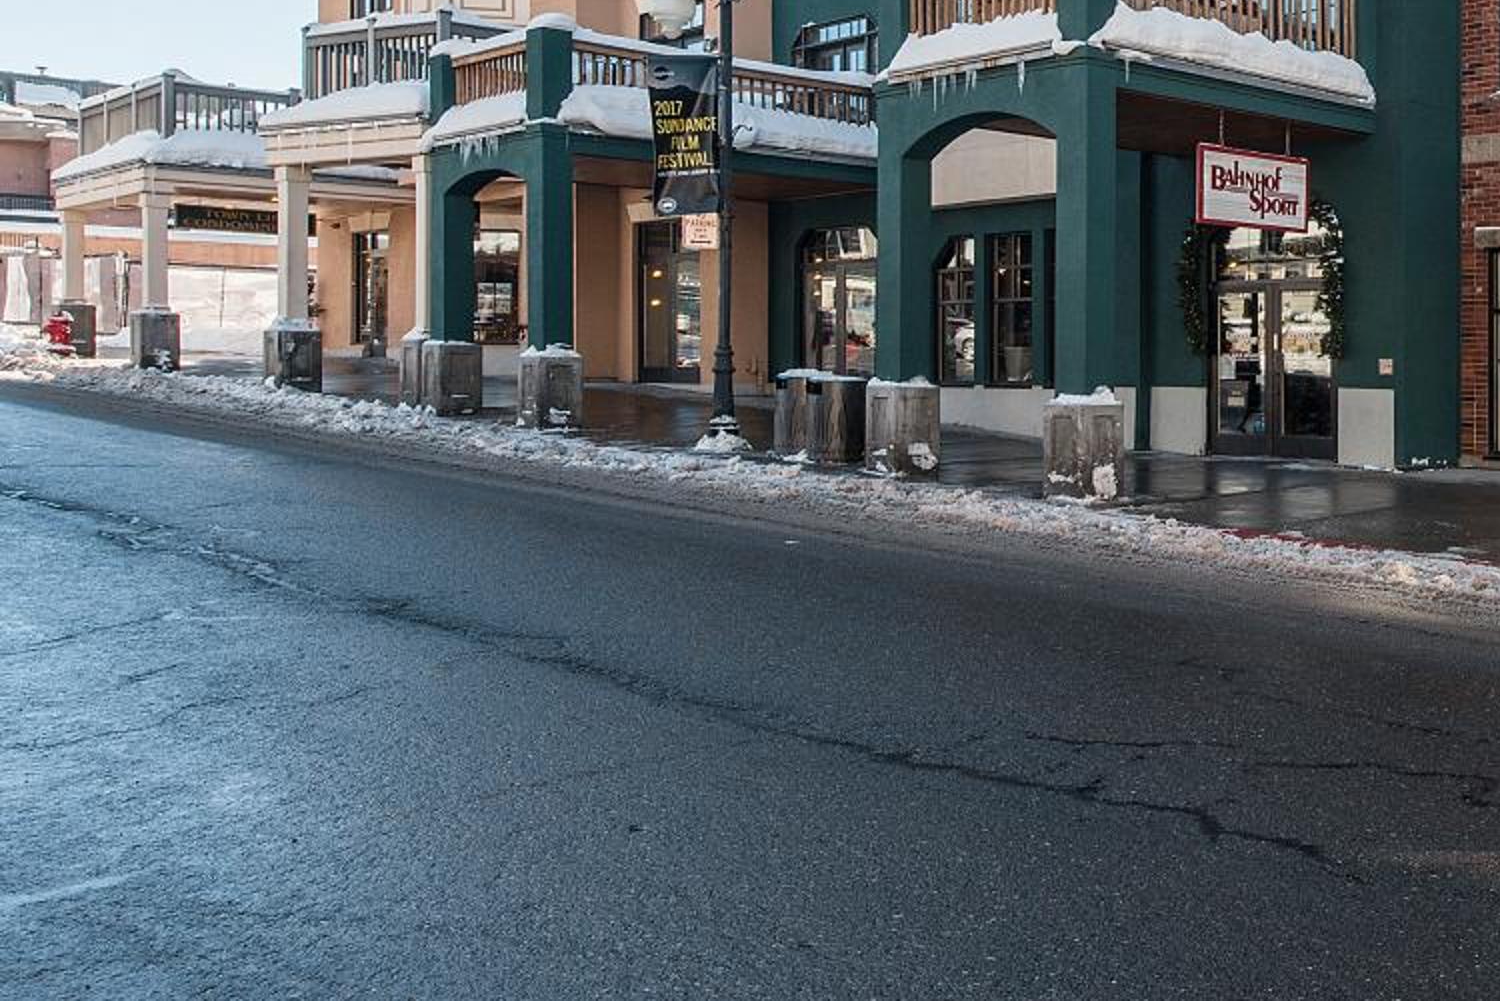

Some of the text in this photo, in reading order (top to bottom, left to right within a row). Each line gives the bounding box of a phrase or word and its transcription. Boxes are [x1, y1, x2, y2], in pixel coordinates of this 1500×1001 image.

[653, 100, 683, 117] 2017
[656, 116, 718, 134] SUNDANCE
[672, 134, 700, 151] FILM
[657, 151, 713, 170] FESTIVAL
